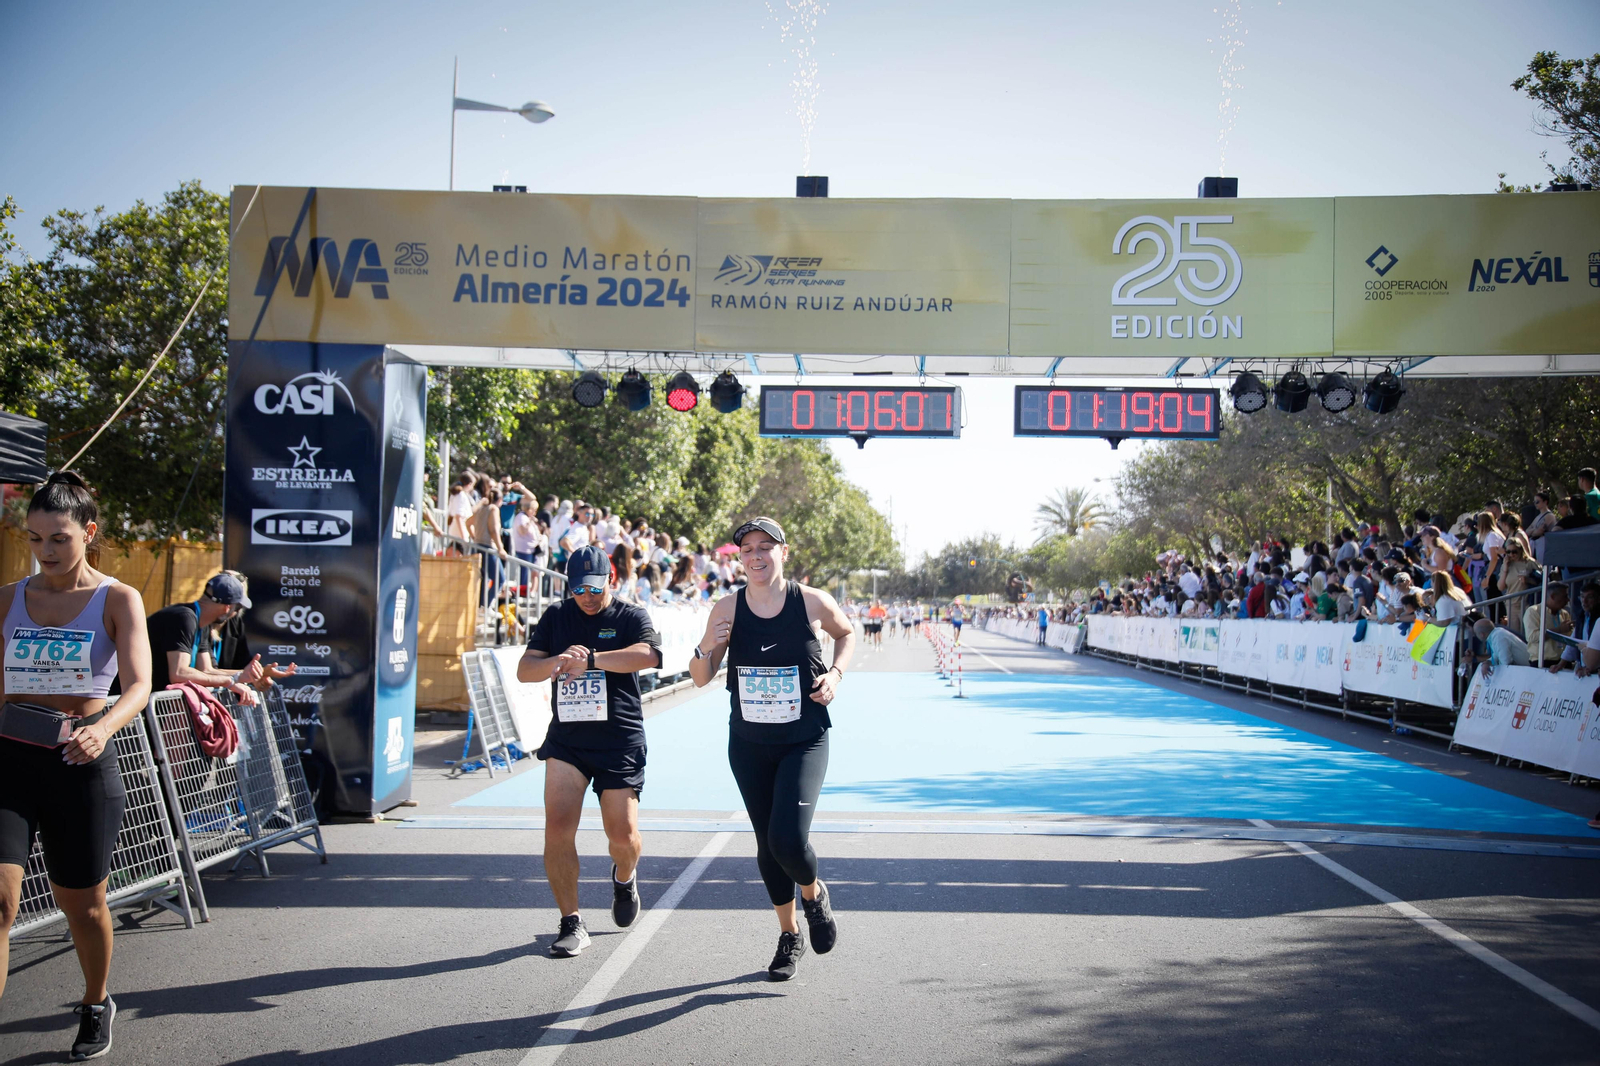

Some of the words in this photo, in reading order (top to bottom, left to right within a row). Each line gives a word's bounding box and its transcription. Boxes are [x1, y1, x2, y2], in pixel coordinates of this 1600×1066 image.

[394, 242, 429, 266] 25
[455, 243, 548, 269] Medio
[562, 246, 691, 272] Maratón
[1110, 214, 1244, 307] 25
[774, 256, 823, 269] RFEA
[393, 266, 429, 276] EDICIÓN
[768, 268, 818, 279] SERIES
[453, 272, 588, 306] Almería
[595, 276, 691, 308] 2024
[763, 278, 795, 287] RUTA
[797, 278, 846, 287] RUNNING
[1364, 278, 1448, 291] COOPERACIÓN
[711, 291, 787, 310] RAMÓN
[796, 296, 845, 311] RUIZ
[852, 293, 953, 313] ANDÚJAR
[1364, 291, 1393, 301] 2005
[1110, 309, 1244, 339] EDICIÓN
[253, 383, 334, 416] CASI
[251, 467, 356, 482] ESTRELLA
[275, 481, 289, 489] DE
[265, 519, 341, 535] IKEA
[281, 565, 320, 576] Barceló
[280, 575, 307, 586] Cabo
[308, 576, 321, 587] de
[280, 586, 304, 597] Gata
[273, 605, 325, 635] ego
[14, 639, 82, 661] 5762
[268, 645, 297, 655] SER
[561, 680, 601, 695] 5915
[745, 677, 795, 694] 5455
[1483, 686, 1515, 708] ALMERÍA
[1478, 707, 1495, 720] CIUDAD
[1539, 696, 1584, 721] ALMERÍA
[1533, 718, 1558, 733] CIUDAD
